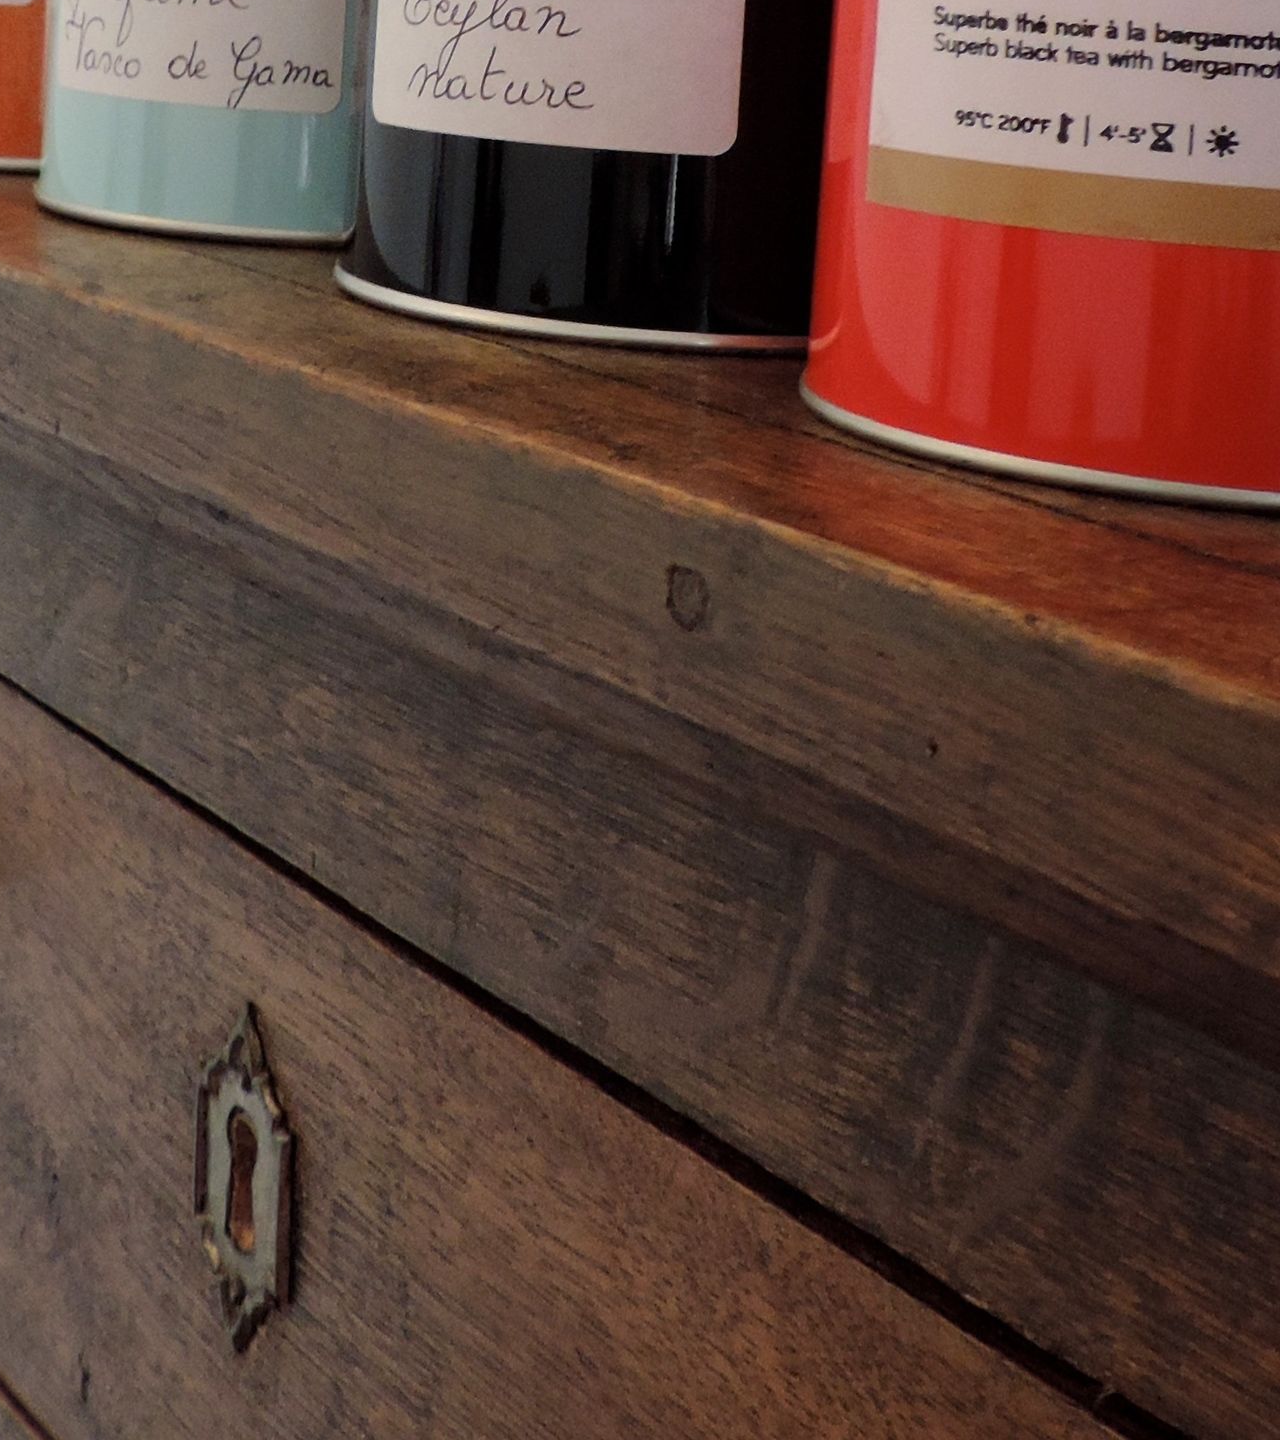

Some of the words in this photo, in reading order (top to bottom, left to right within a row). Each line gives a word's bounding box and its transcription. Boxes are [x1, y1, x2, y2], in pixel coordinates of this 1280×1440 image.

[934, 5, 1008, 32] Superbe
[1015, 13, 1047, 35] thé
[1055, 17, 1098, 38] noir
[1104, 20, 1119, 40] à
[1127, 20, 1146, 42] la
[934, 32, 998, 58] Superb
[1005, 39, 1059, 63] black
[1066, 45, 1100, 66] tea
[1108, 50, 1153, 71] with
[167, 40, 210, 80] de
[228, 36, 335, 109] Gama
[407, 46, 595, 110] nature
[955, 109, 993, 129] 95°C
